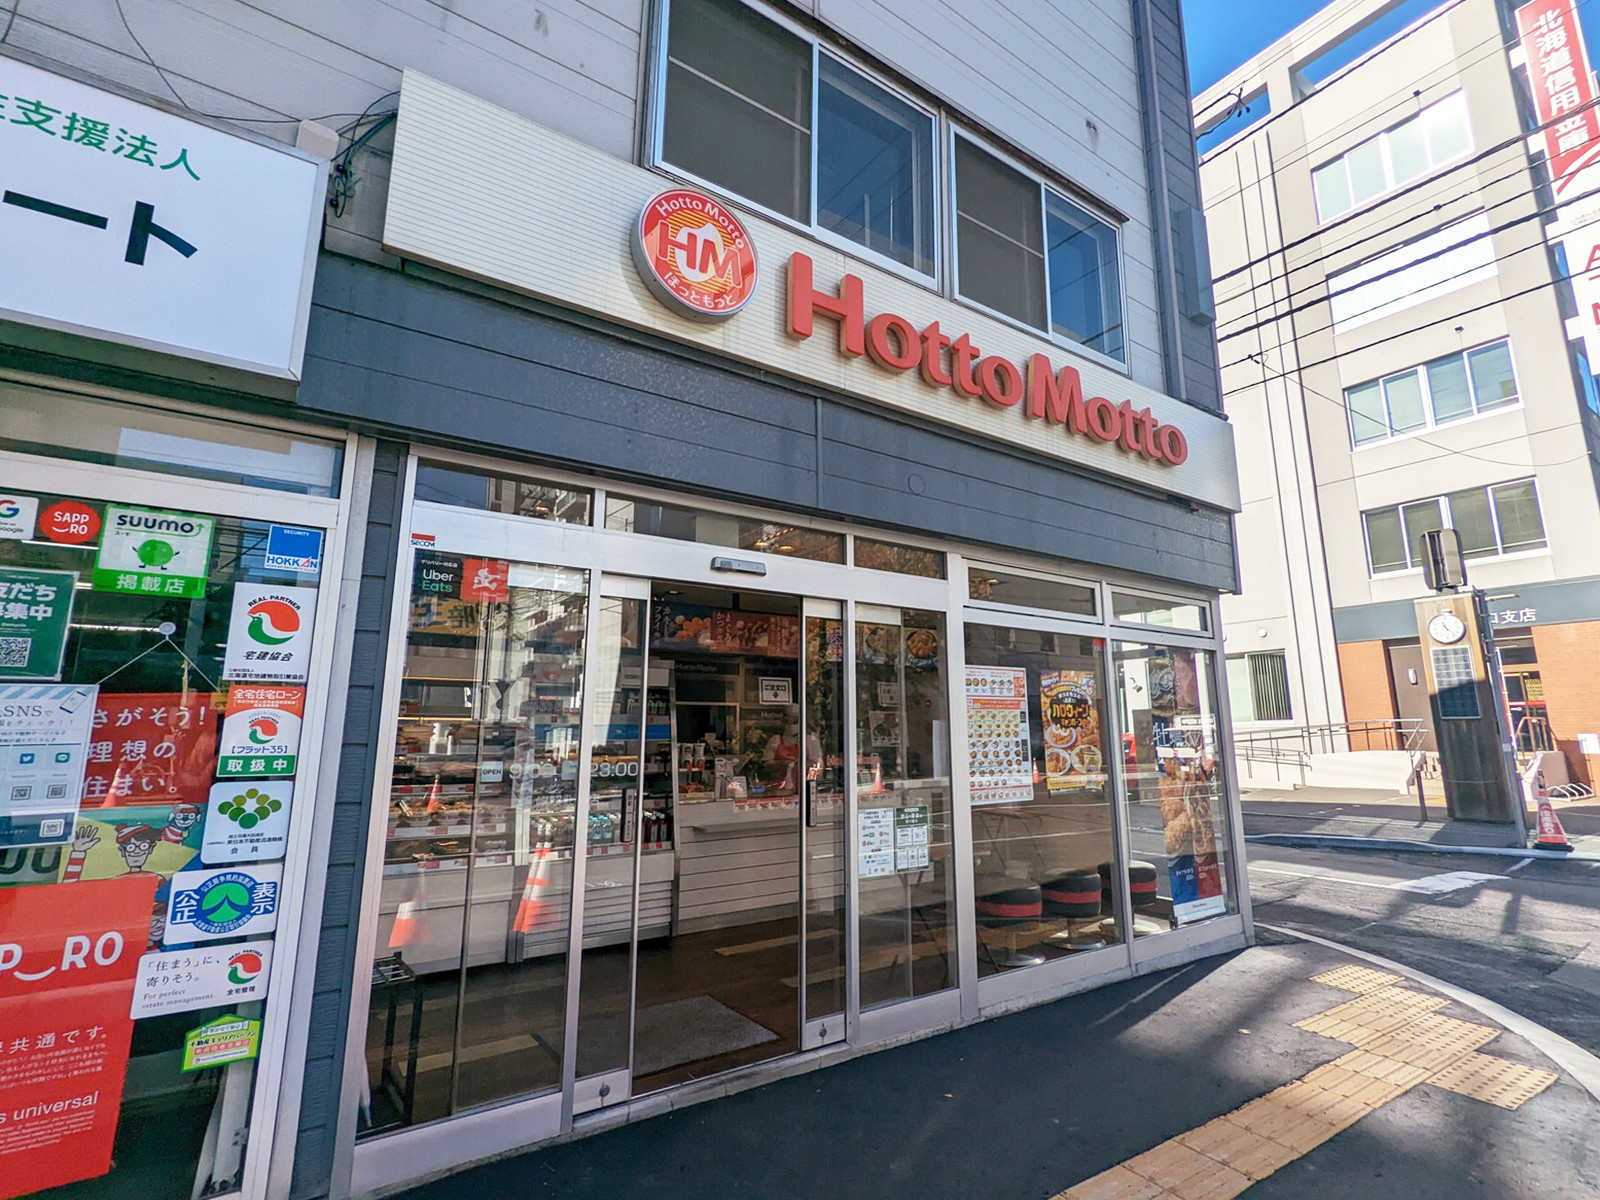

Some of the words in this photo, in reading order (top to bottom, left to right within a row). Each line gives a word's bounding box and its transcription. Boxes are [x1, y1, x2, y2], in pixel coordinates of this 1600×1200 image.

[1533, 8, 1590, 157] 北海道信用金庫
[664, 271, 736, 309] ほっともっと
[53, 511, 90, 524] SAPP
[423, 569, 454, 582] Uber
[116, 574, 185, 594] 掲載店
[421, 581, 453, 593] Eats
[0, 601, 53, 621] 集中
[247, 596, 268, 607] REAL
[269, 595, 302, 611] PARTNER
[243, 650, 294, 662] 宅建協会
[233, 688, 301, 700] 全宅住宅ローン
[87, 740, 176, 763] 理想の
[227, 758, 288, 772] 取扱中
[481, 768, 503, 776] OPEN
[83, 775, 177, 798] 住まい。
[250, 882, 276, 914] 表示
[171, 890, 201, 925] 公正
[148, 956, 220, 972] 「住まう」に、
[146, 972, 200, 988] 寄りそう。
[143, 992, 157, 1000] For
[158, 988, 186, 1000] perfect
[226, 985, 256, 996] 全宅管理
[0, 1026, 107, 1055] 共通です。
[13, 1091, 99, 1121] universal
